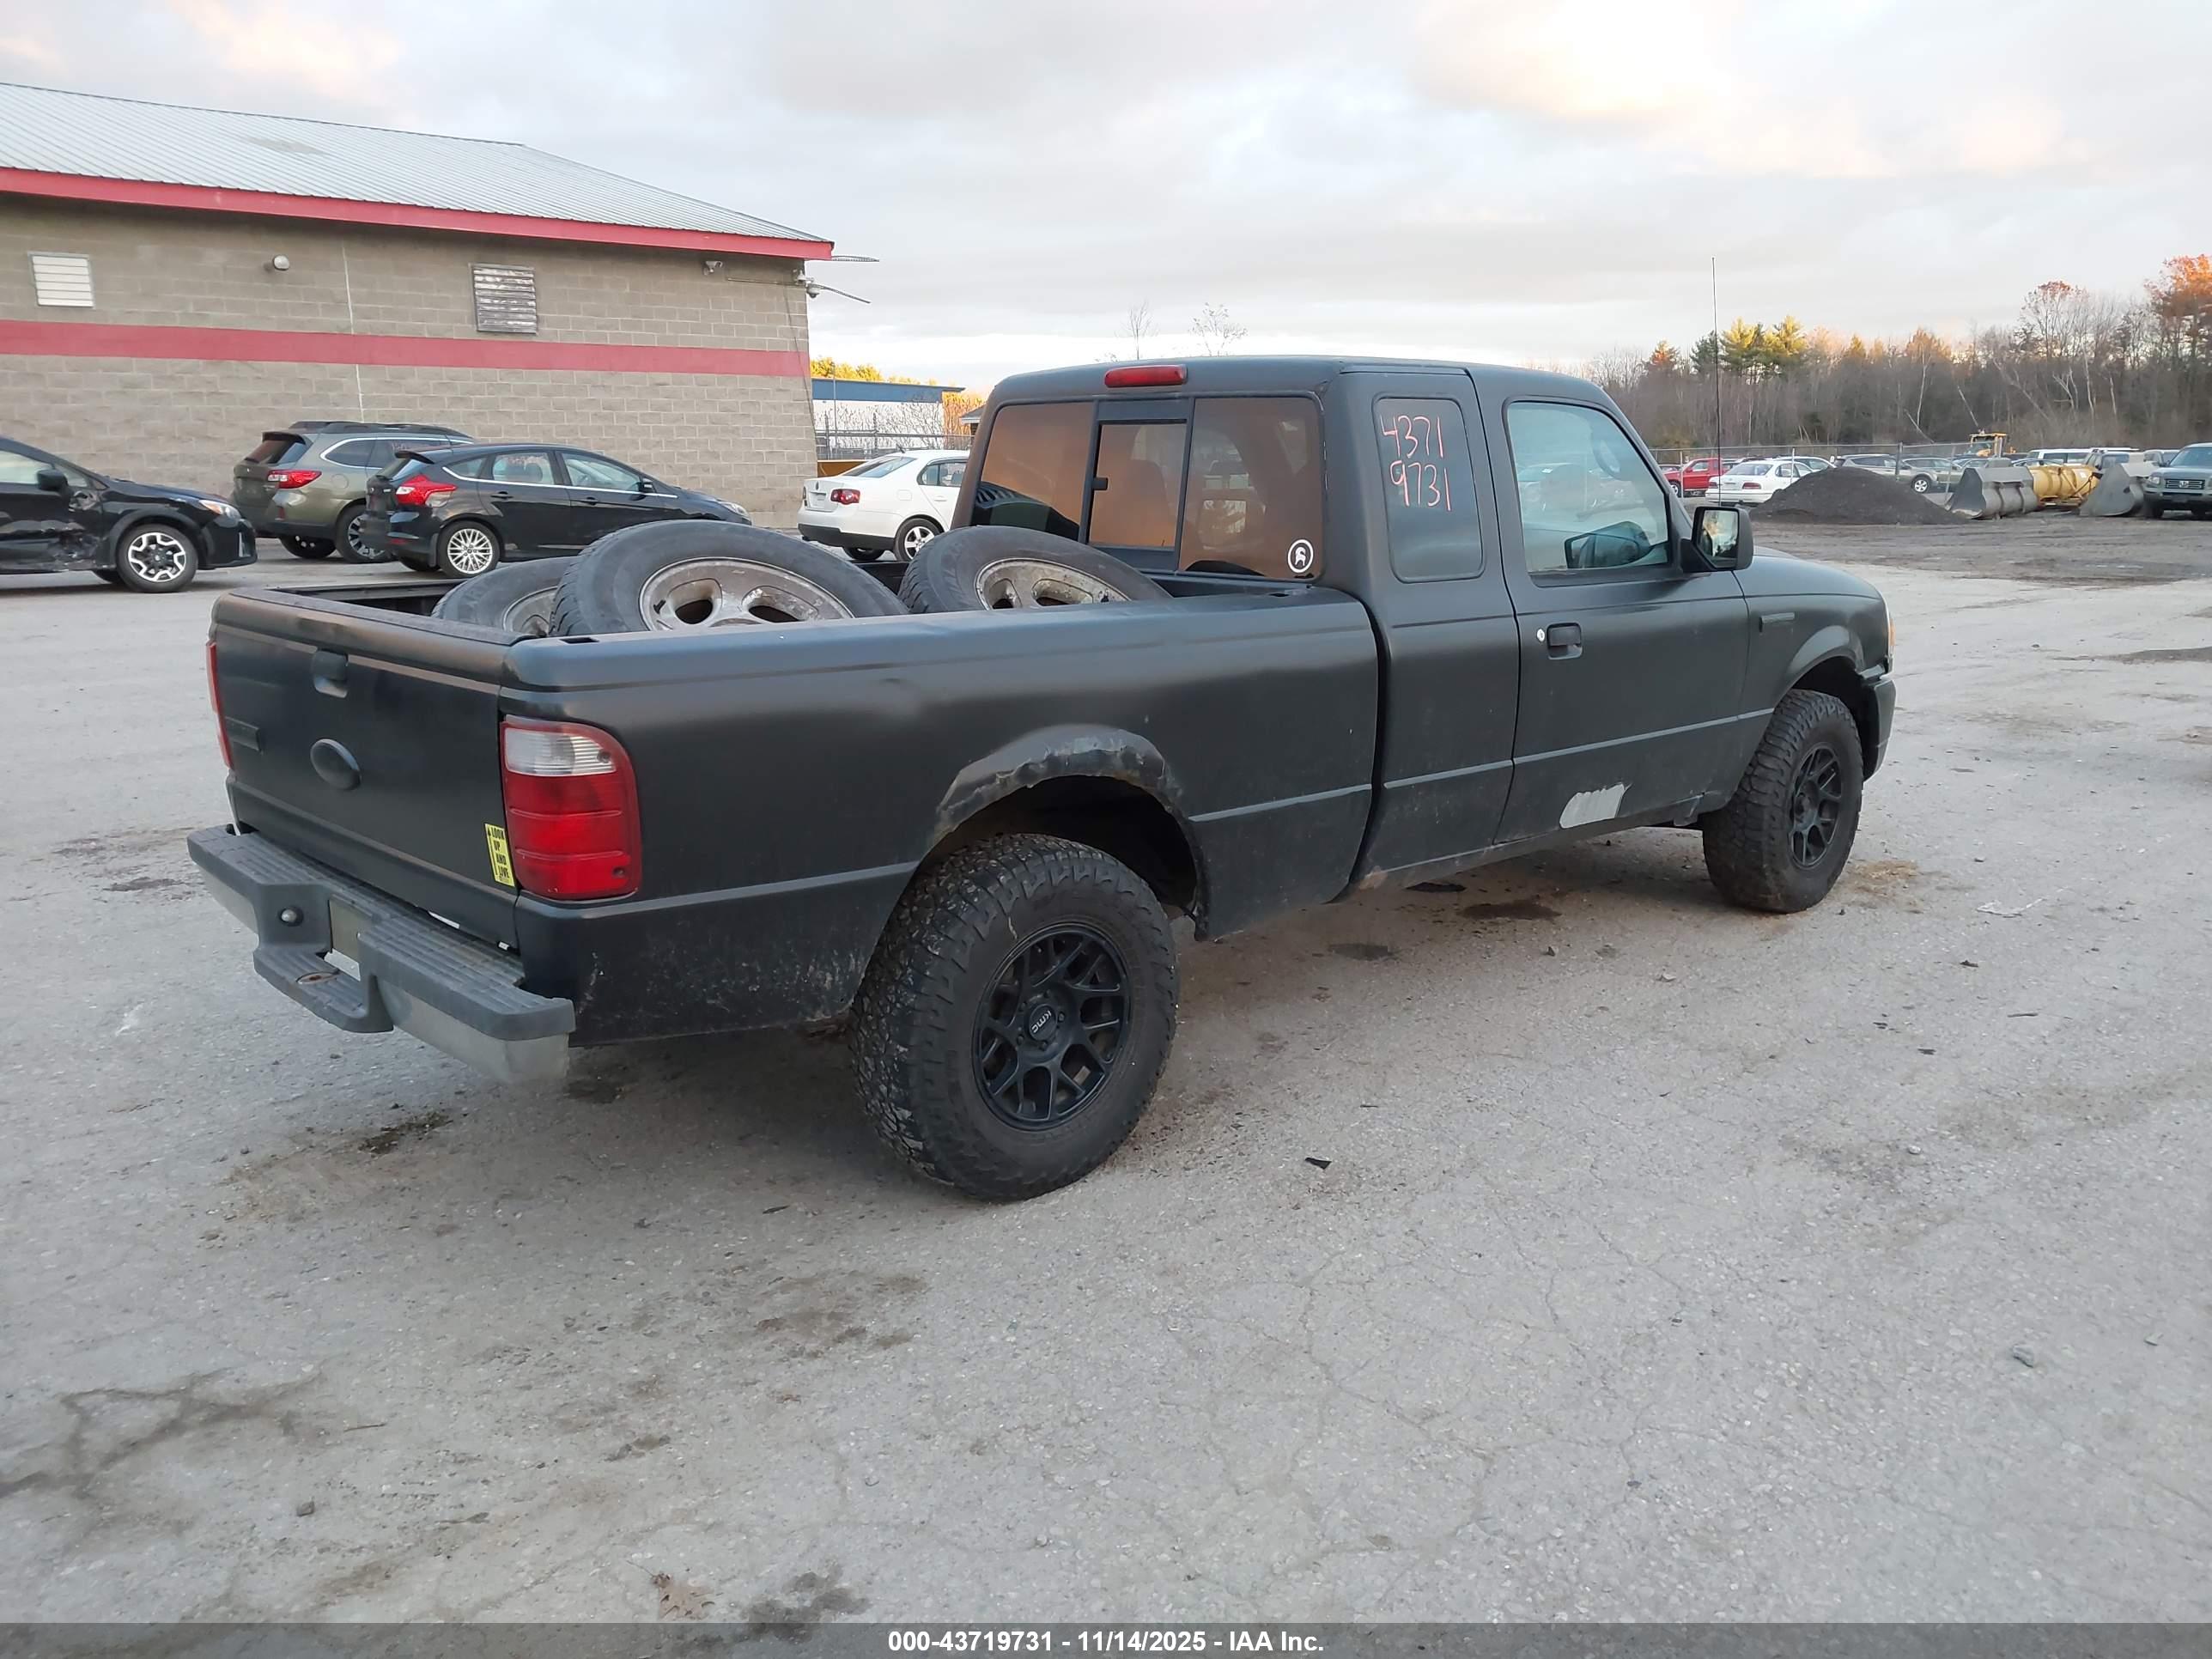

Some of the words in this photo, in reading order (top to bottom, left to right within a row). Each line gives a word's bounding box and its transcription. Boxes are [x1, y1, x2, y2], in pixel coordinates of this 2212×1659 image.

[1379, 415, 1443, 459] 4371
[1389, 459, 1451, 512] 9731
[491, 826, 505, 841] LOOK
[494, 840, 501, 852] UP
[495, 853, 507, 866] AND
[498, 865, 510, 879] LIVE
